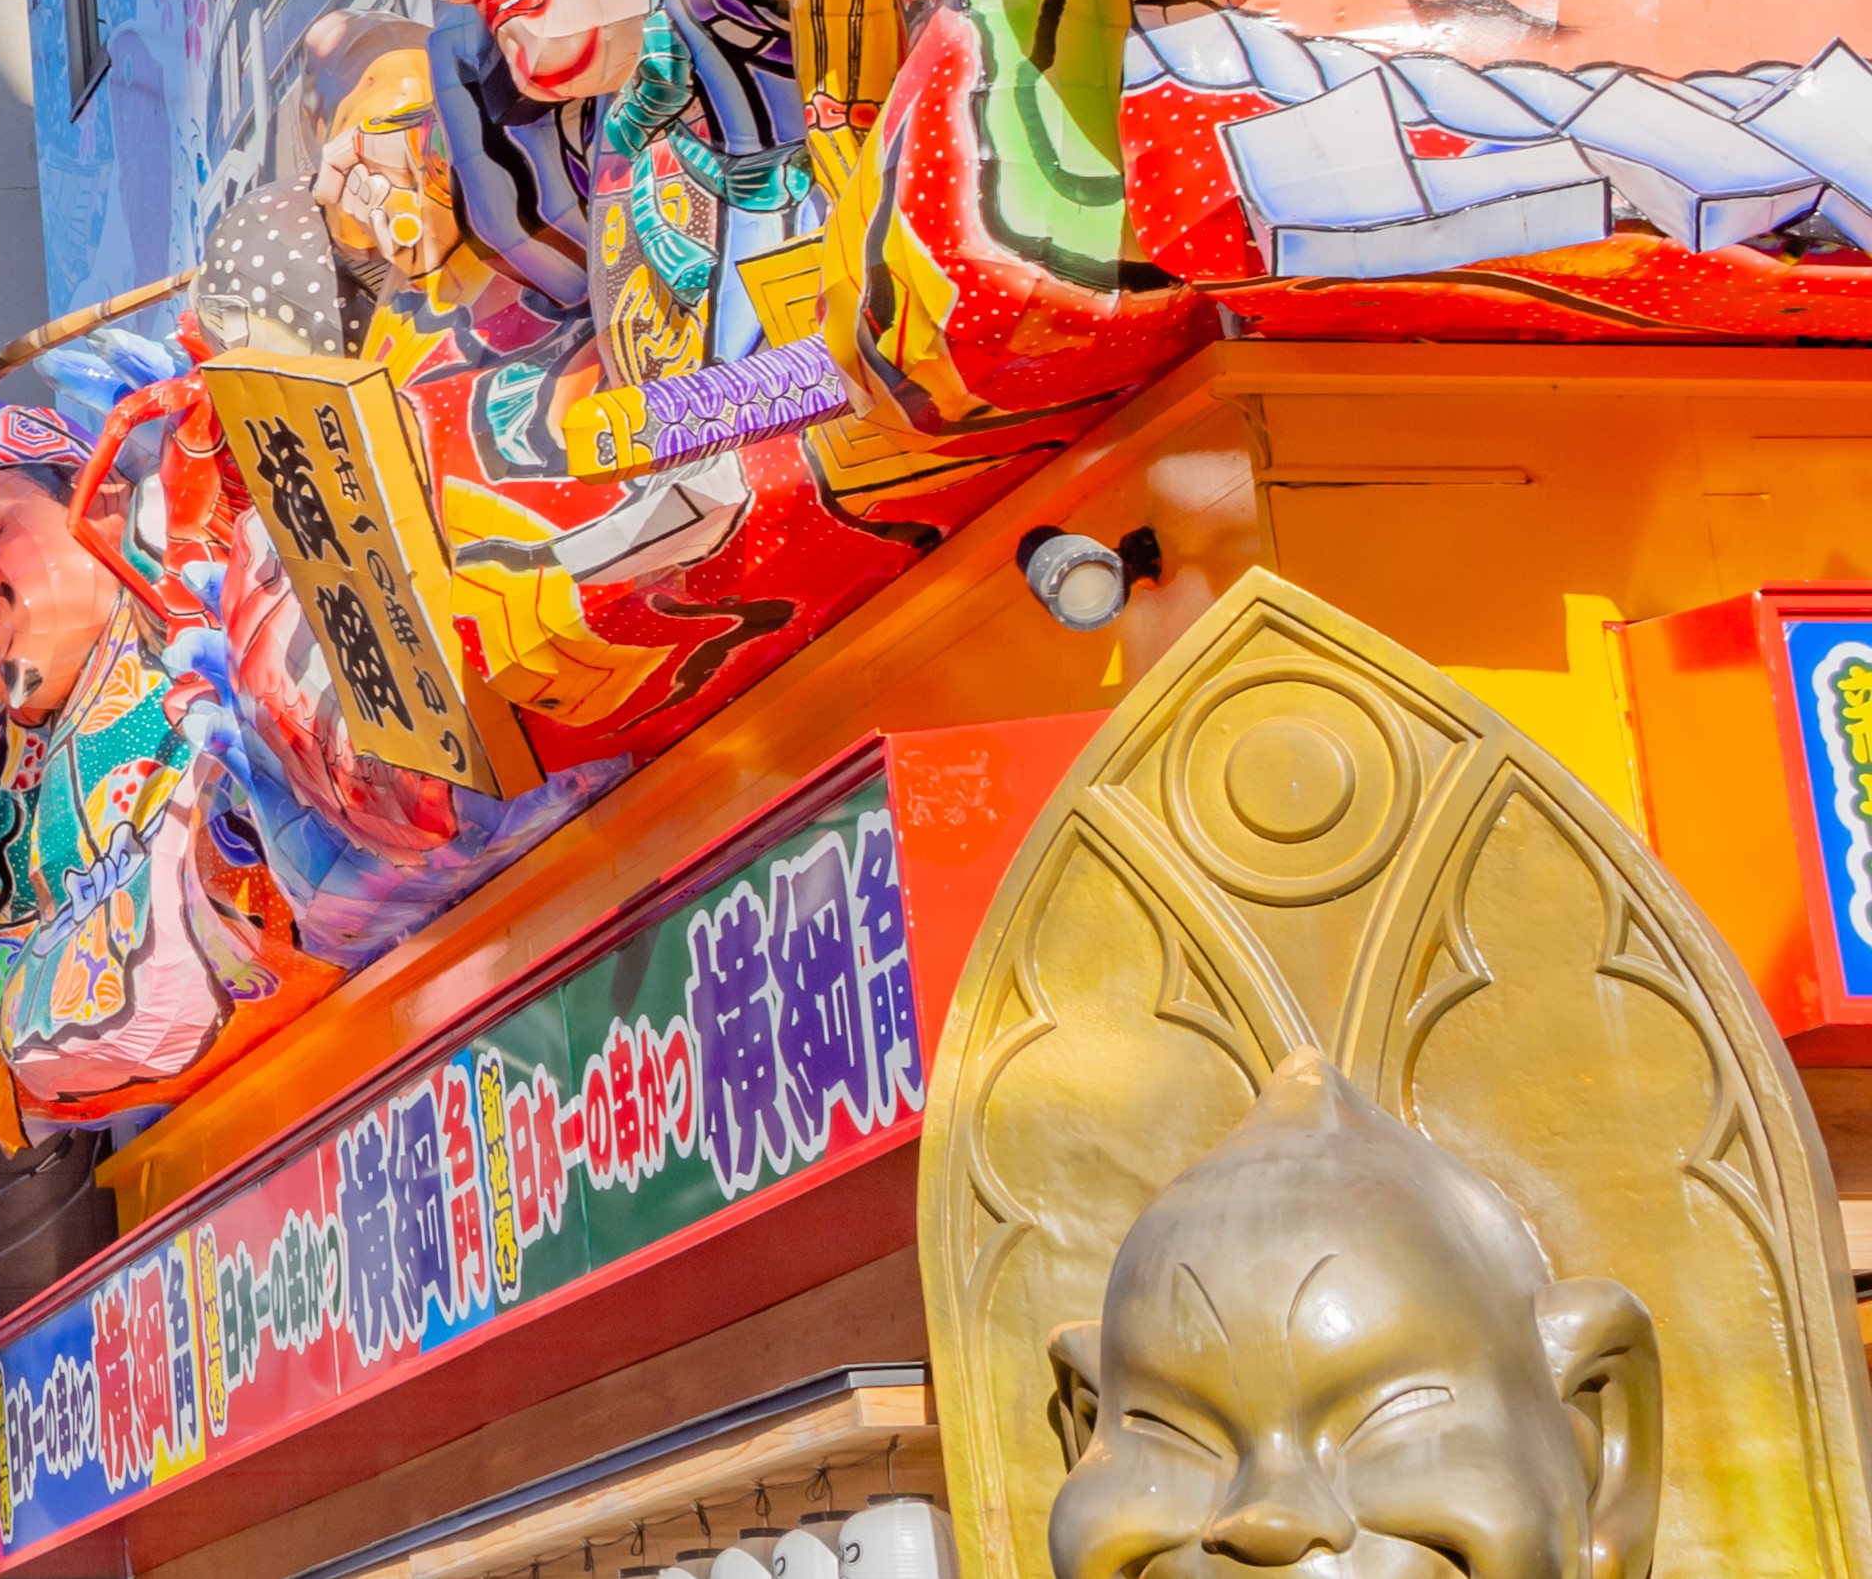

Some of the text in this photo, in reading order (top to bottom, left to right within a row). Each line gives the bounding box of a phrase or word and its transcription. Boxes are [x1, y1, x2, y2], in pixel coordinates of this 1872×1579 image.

[314, 404, 467, 773] 日本一の串かつ
[509, 846, 869, 1228] 日本一の串かつ 横綱
[856, 827, 924, 1110] 名門
[219, 1092, 452, 1382] 日本一の串かつ 横綱
[442, 1078, 485, 1307] 名門
[480, 1061, 518, 1289] 新世界
[7, 1266, 173, 1501] 日本一の串かつ 横綱
[167, 1258, 197, 1449] 名門
[199, 1231, 225, 1423] 新世界
